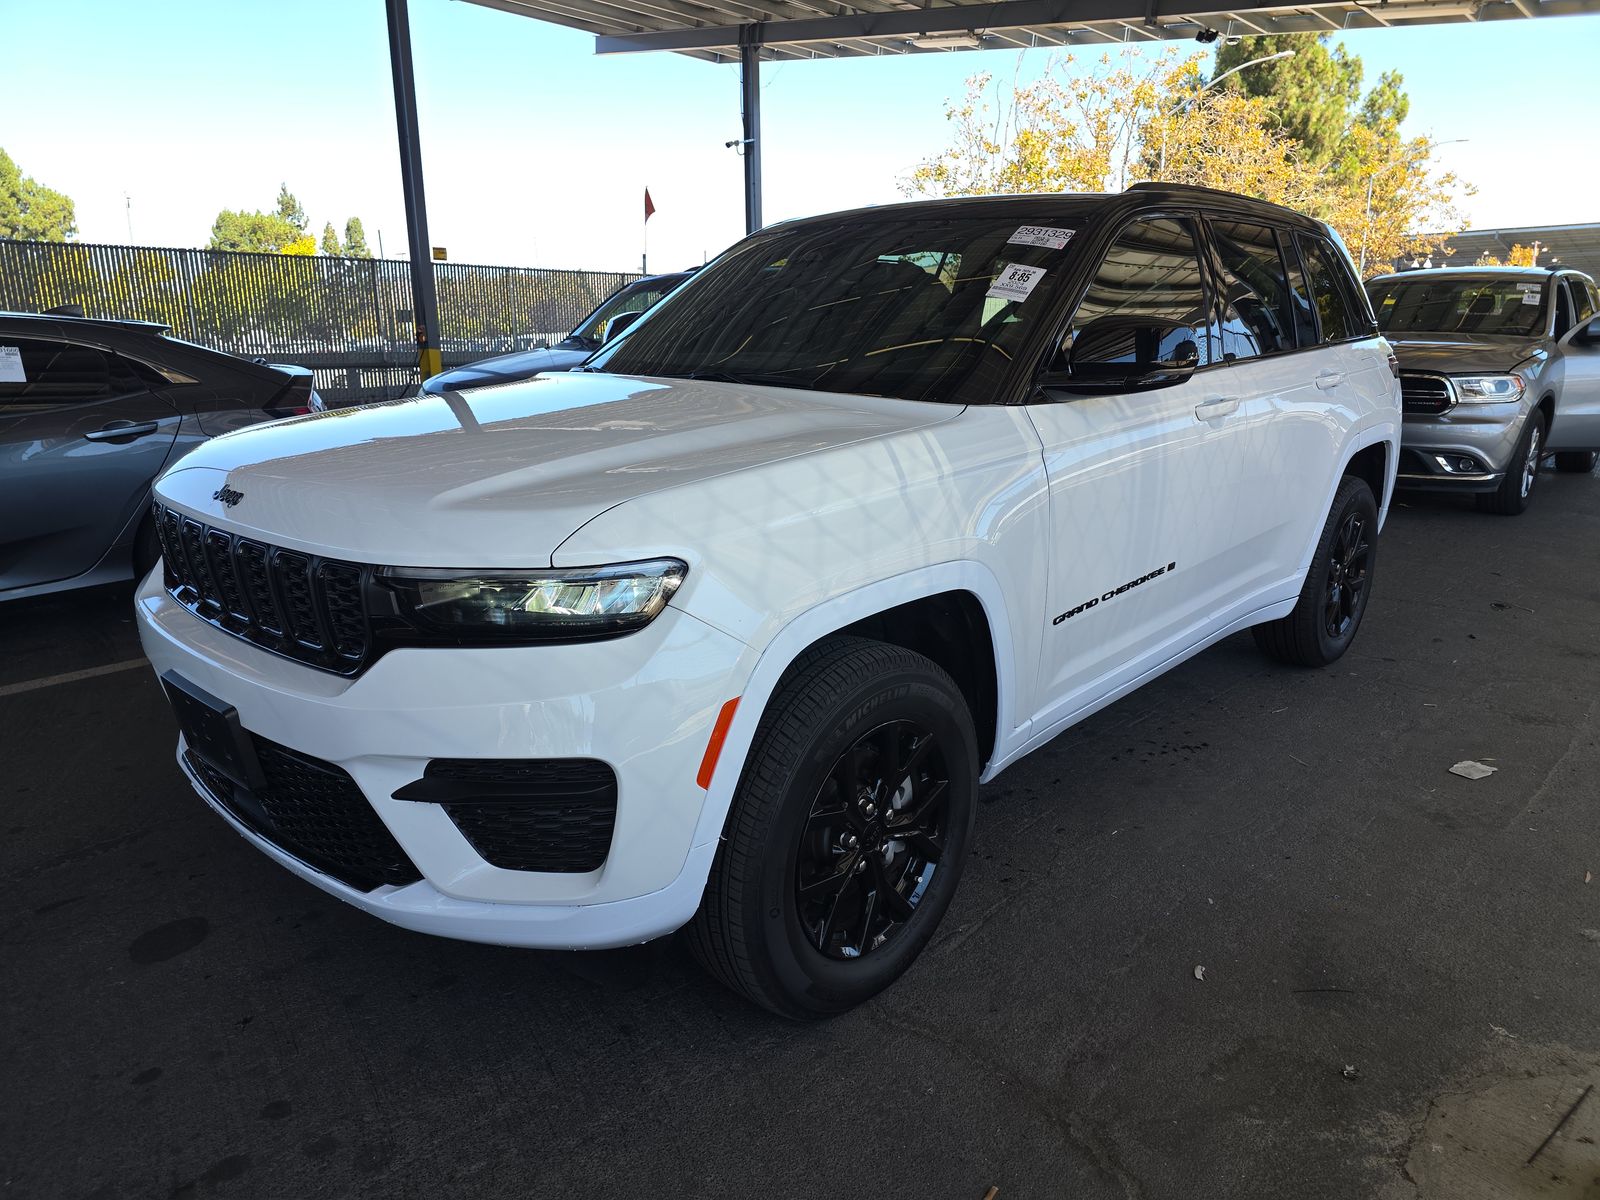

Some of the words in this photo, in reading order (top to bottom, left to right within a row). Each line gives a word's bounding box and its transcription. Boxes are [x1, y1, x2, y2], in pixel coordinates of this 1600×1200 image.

[1017, 227, 1073, 240] 2931329
[1009, 271, 1032, 283] 8:85
[1053, 598, 1099, 626] GRAND
[1102, 567, 1166, 602] CHEROKEE
[845, 686, 909, 730] MICHELIN
